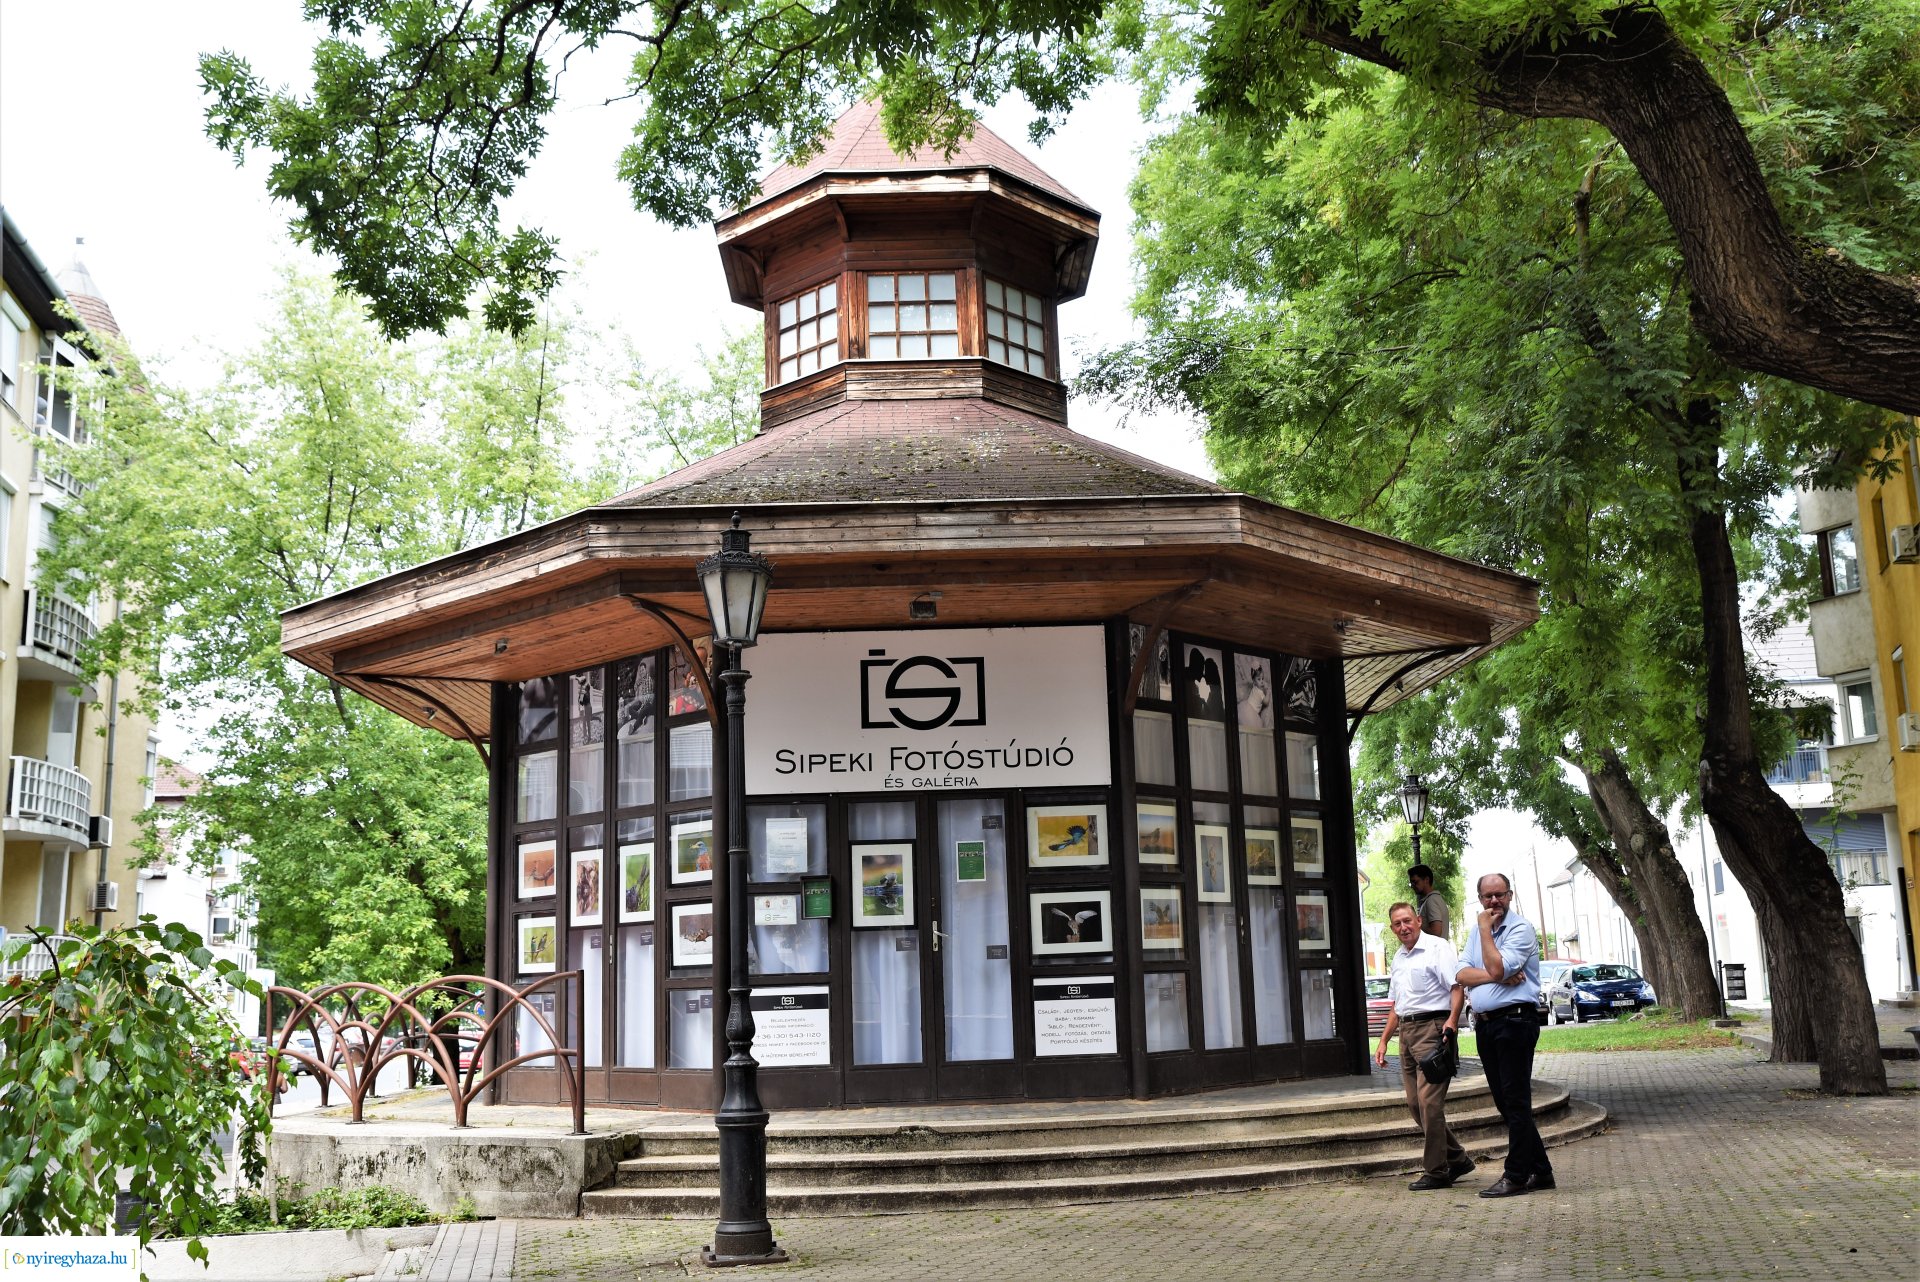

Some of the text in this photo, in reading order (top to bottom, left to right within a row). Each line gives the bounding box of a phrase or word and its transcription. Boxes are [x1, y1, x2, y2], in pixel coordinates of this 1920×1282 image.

[775, 737, 1074, 774] SIPEKI FOTÓSTÚDIÓ
[884, 773, 979, 788] ÉS GALÉRIA
